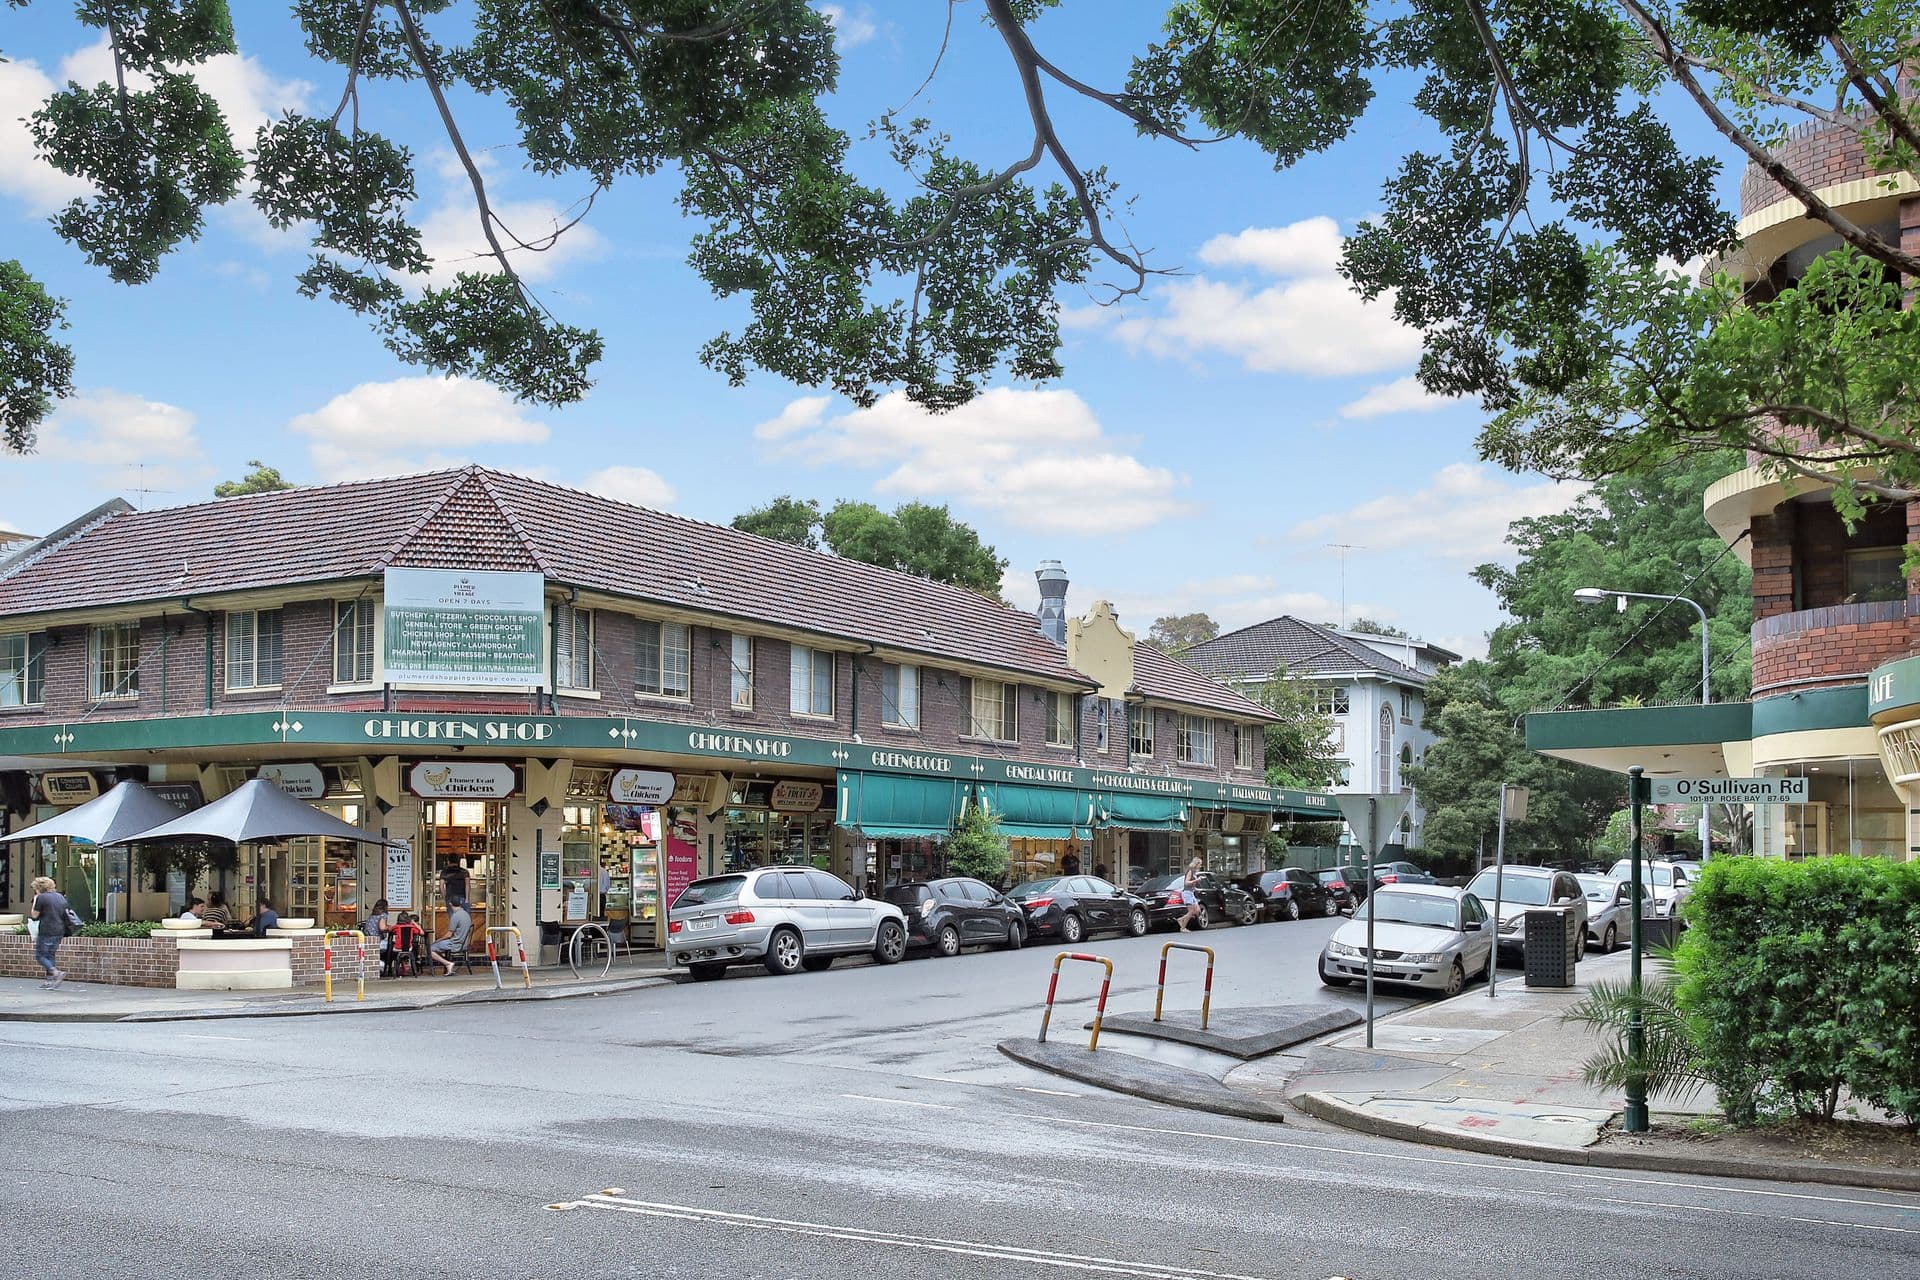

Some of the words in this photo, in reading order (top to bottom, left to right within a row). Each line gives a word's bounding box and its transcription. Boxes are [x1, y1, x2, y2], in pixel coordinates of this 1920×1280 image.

[390, 610, 428, 619] BUTCHERY
[435, 612, 467, 620] PIZZERIA
[474, 613, 517, 621] CHOCOLATE
[461, 632, 501, 640] PATISSERIE
[507, 633, 526, 641] CAFE
[410, 640, 461, 648] NEWSAGENCY
[468, 641, 517, 649] LAUNDROMAT
[391, 648, 432, 656] PHARMACY
[438, 650, 487, 658] HAIRDRESSER
[493, 651, 536, 659] BEAUTICIAN
[427, 662, 453, 670] MEDICAL
[505, 665, 537, 673] THERAPIES
[1869, 672, 1895, 706] CAFE
[364, 719, 479, 739] CHICKEN
[484, 721, 553, 741] SHOP
[688, 731, 753, 754] CHICKEN
[755, 738, 792, 757] SHOP
[871, 751, 952, 773] GREENGROCER
[1005, 764, 1046, 781] GENERAL
[1047, 768, 1074, 784] STORE
[445, 784, 495, 793] Chickens
[1103, 774, 1150, 790] CHOCOLATES
[1150, 780, 1157, 791] &
[1157, 780, 1183, 793] GELATO
[1676, 779, 1772, 794] O'Sullivan
[1780, 779, 1804, 794] Rd
[630, 790, 660, 799] Chickens
[1232, 787, 1255, 800] ITALIAN
[1255, 790, 1272, 801] PIZZA
[1305, 795, 1326, 806] BUTCHER
[674, 855, 693, 863] foodora
